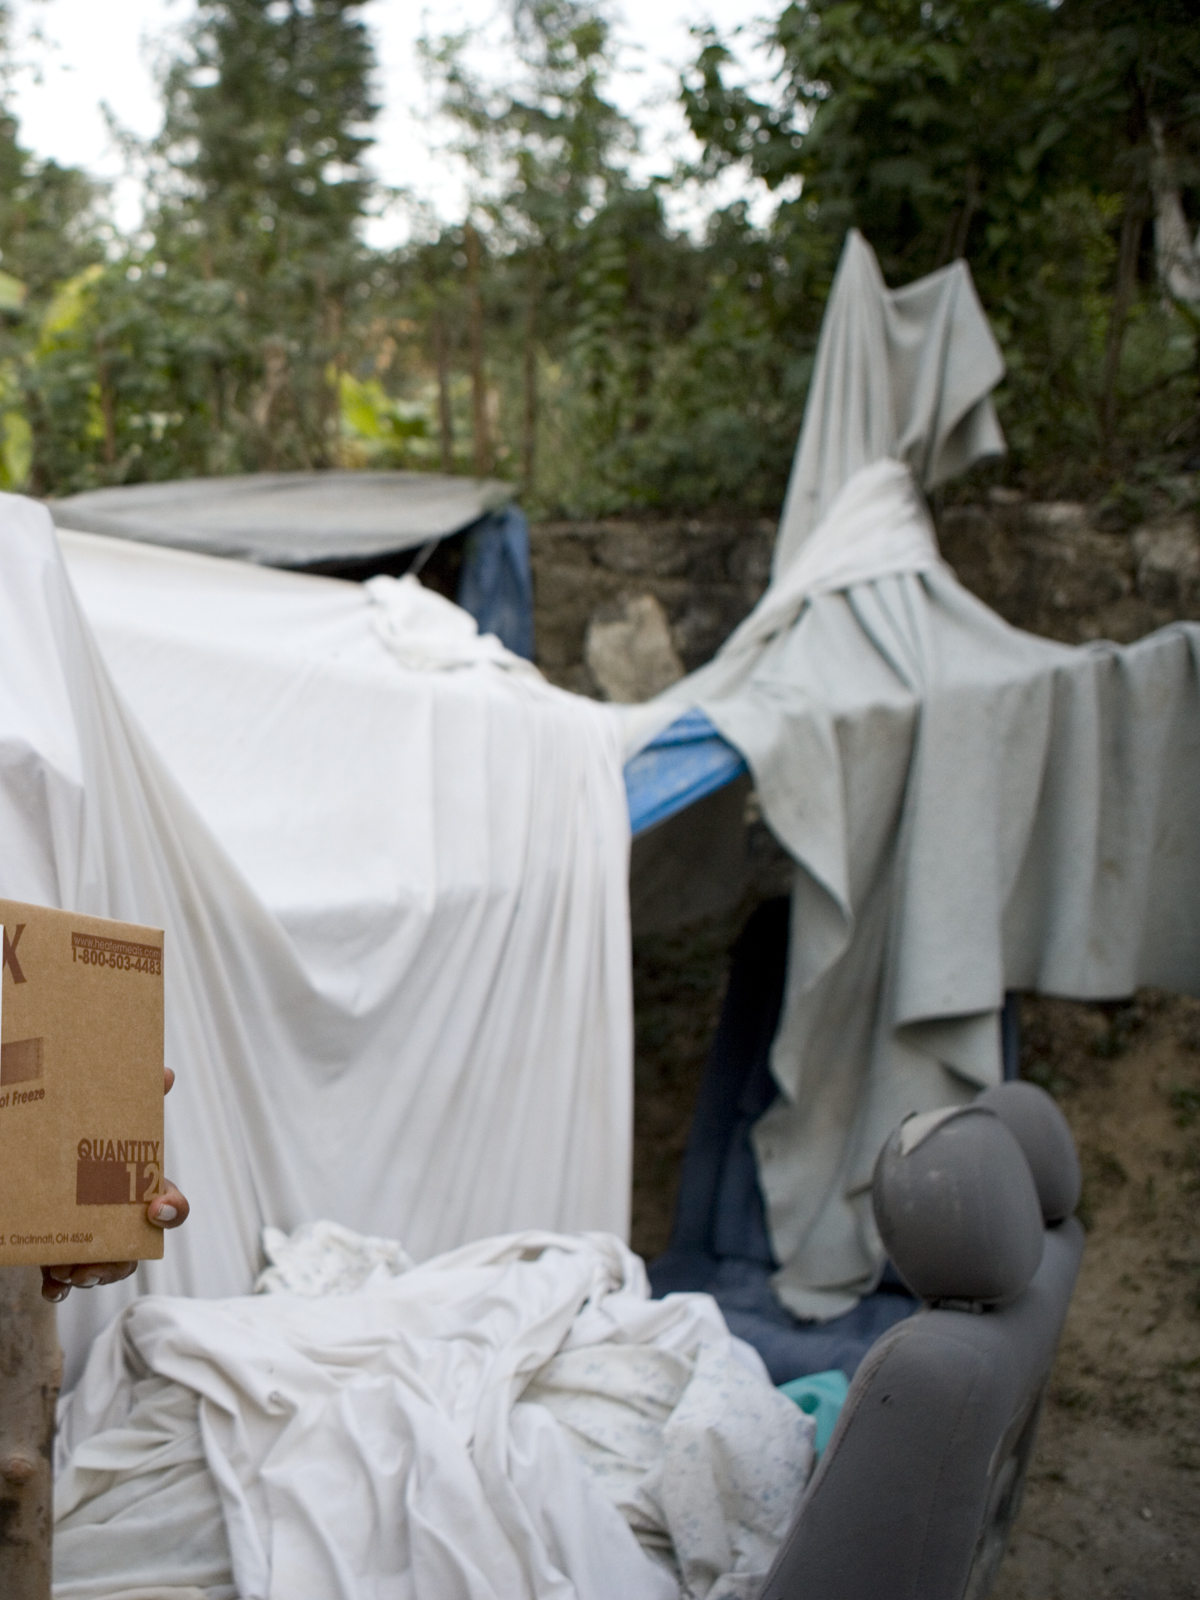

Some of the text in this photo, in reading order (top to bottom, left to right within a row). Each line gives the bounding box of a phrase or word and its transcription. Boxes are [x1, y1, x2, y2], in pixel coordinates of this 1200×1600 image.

[73, 935, 161, 960] www.heatermeals.com
[72, 947, 161, 976] 1-800-503-4483
[0, 1087, 46, 1109] ot Freeze
[77, 1138, 160, 1162] QUANTITY
[126, 1163, 160, 1202] 12
[56, 1232, 68, 1243] OH
[70, 1231, 93, 1243] 45246
